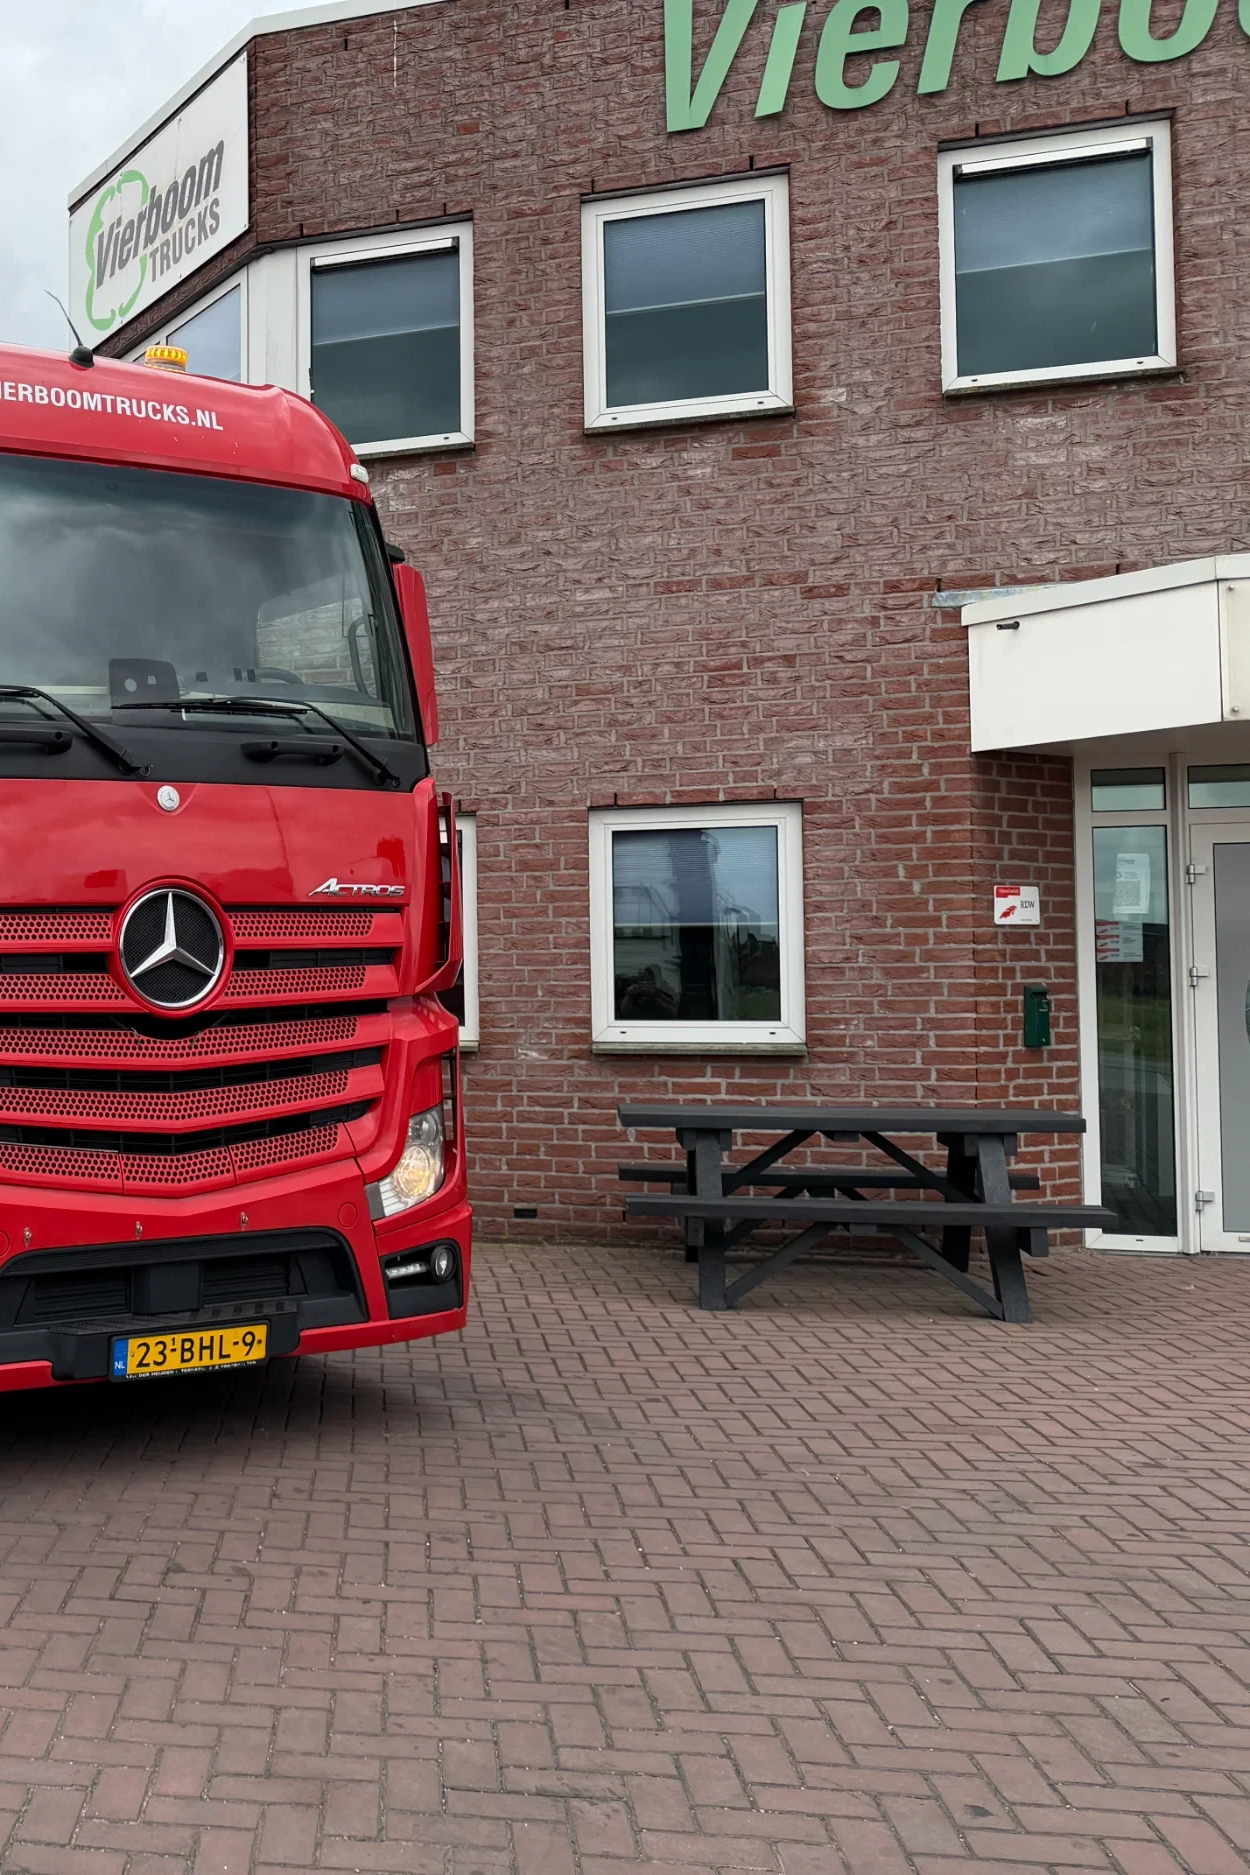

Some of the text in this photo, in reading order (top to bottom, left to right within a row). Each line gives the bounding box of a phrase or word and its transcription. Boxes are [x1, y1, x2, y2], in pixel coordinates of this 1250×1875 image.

[664, 0, 1250, 132] Vierbo
[96, 139, 225, 290] Vierboom
[150, 197, 220, 282] TRUCKS
[1020, 900, 1035, 909] RDW
[114, 1361, 125, 1370] NL
